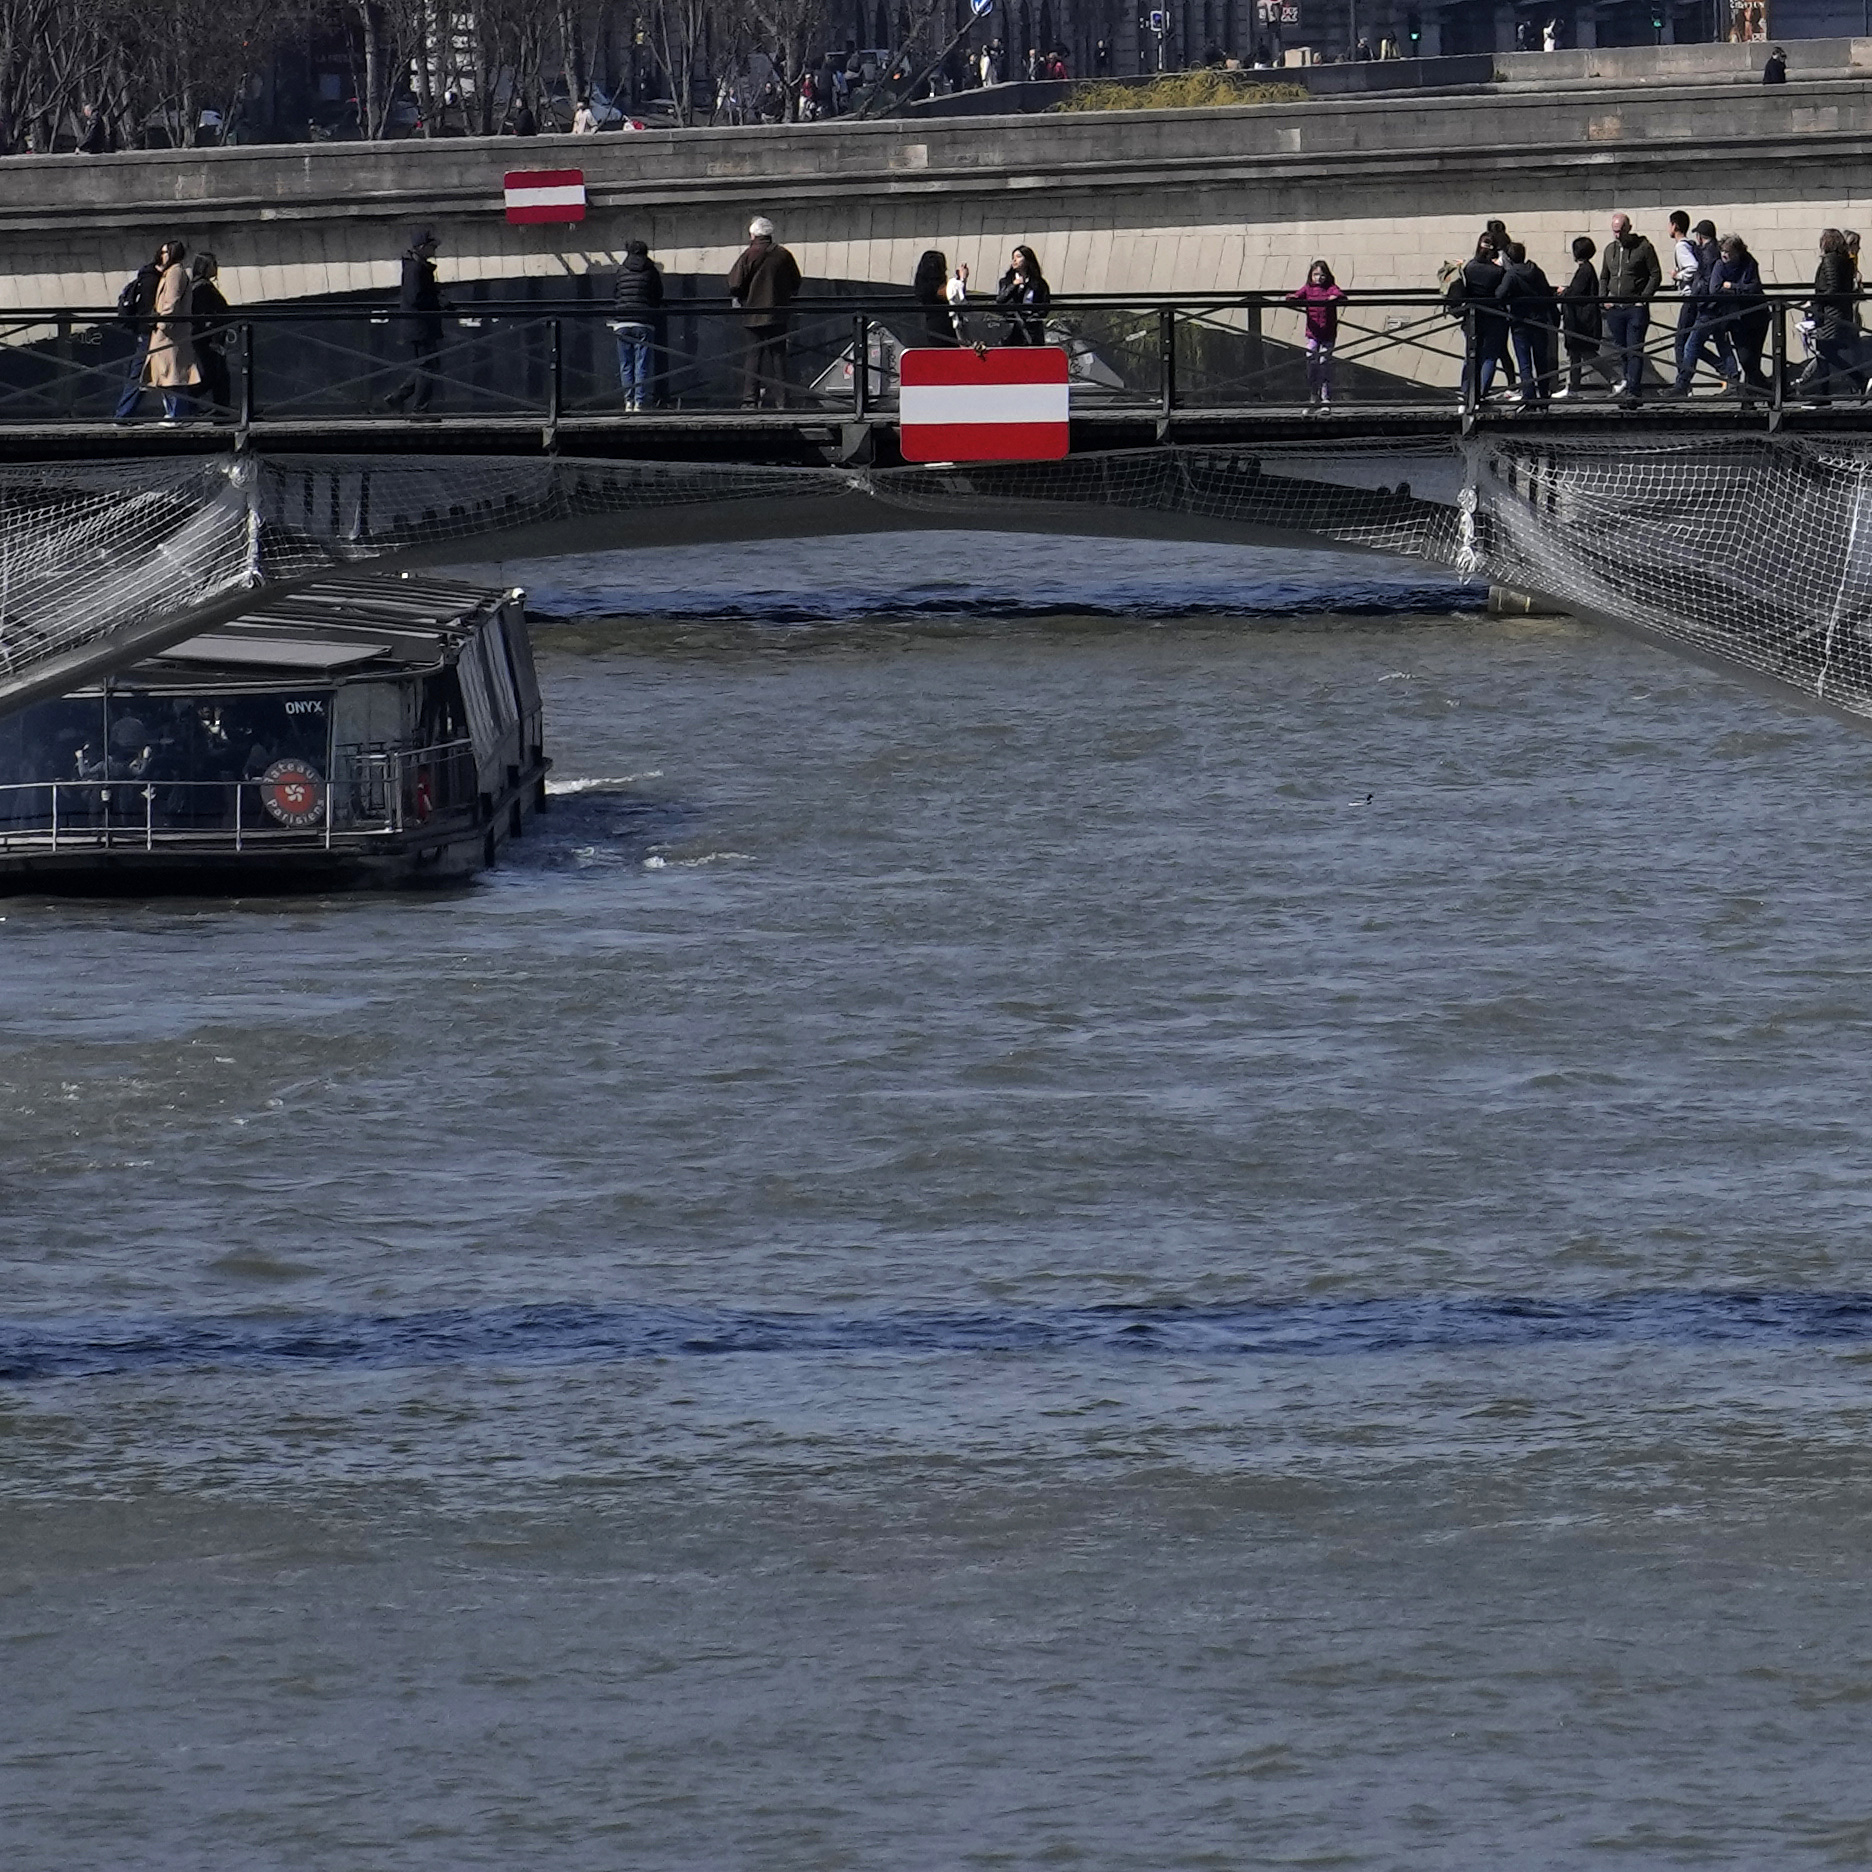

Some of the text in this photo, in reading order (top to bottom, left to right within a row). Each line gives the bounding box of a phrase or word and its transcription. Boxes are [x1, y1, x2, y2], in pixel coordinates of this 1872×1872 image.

[284, 700, 324, 715] ONYX
[262, 762, 318, 788] ateau
[266, 798, 325, 825] Parisiens
